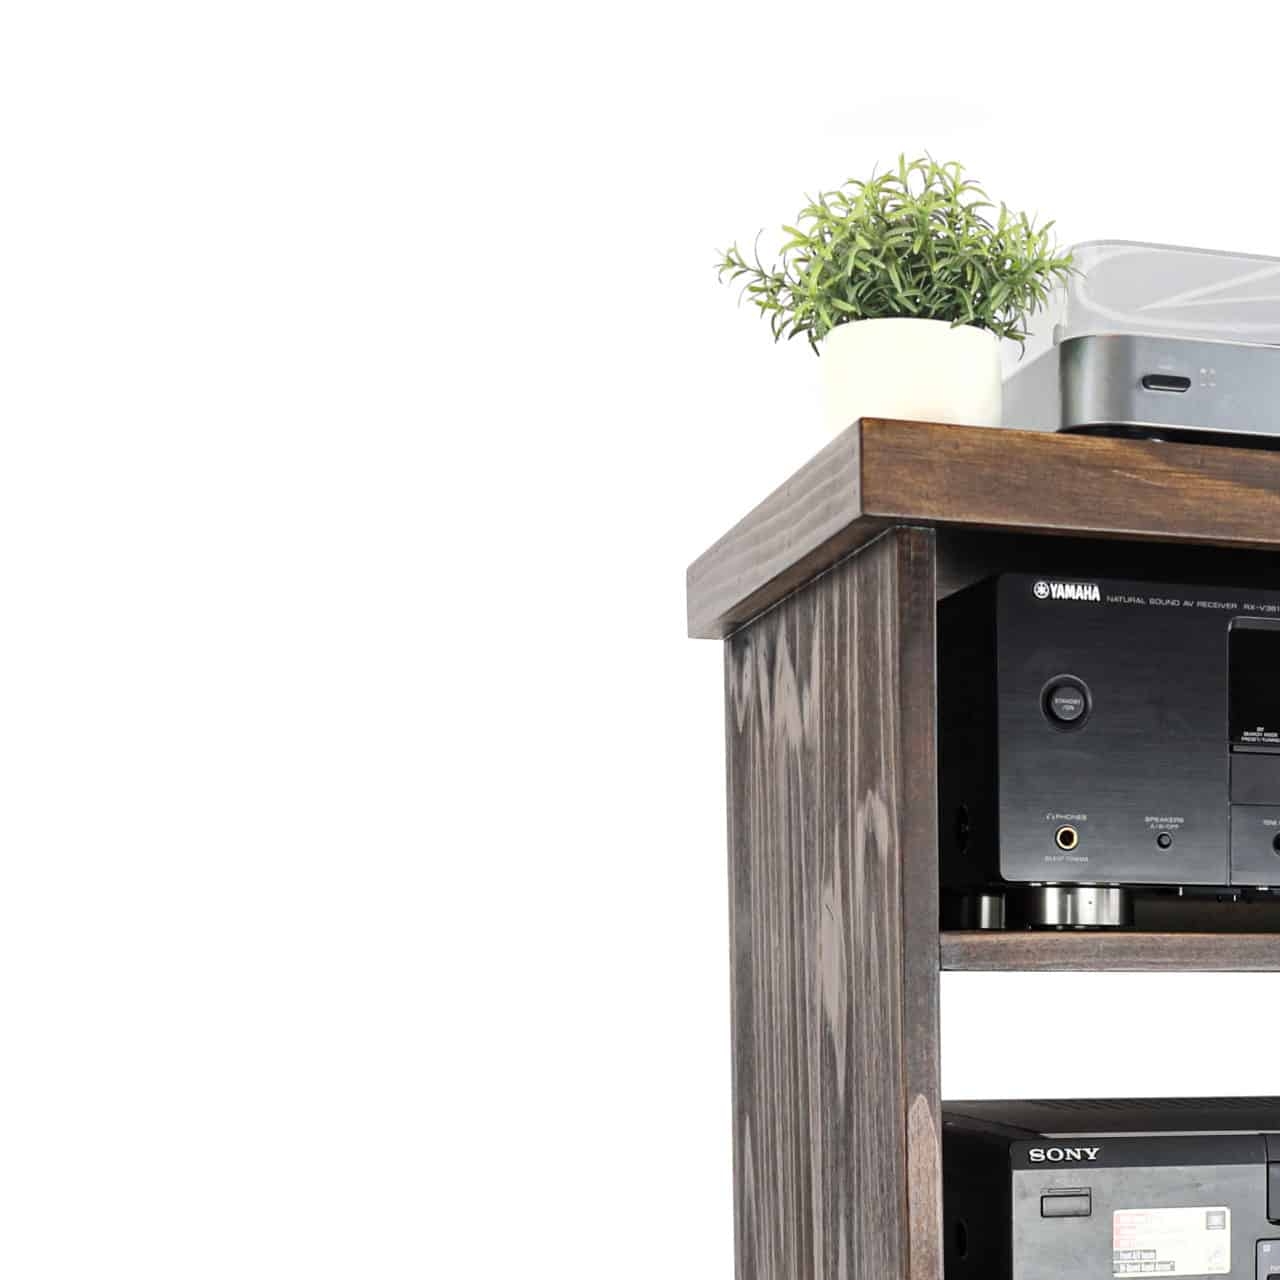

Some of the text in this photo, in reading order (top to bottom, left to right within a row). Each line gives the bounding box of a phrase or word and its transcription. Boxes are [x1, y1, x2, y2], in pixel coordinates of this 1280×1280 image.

[1049, 583, 1101, 601] YAMAHA
[1105, 594, 1146, 604] NATURAL
[1149, 598, 1181, 607] SOUND
[1183, 600, 1195, 608] AV
[1196, 601, 1238, 610] RECEIVER
[1028, 1147, 1100, 1162] SONY
